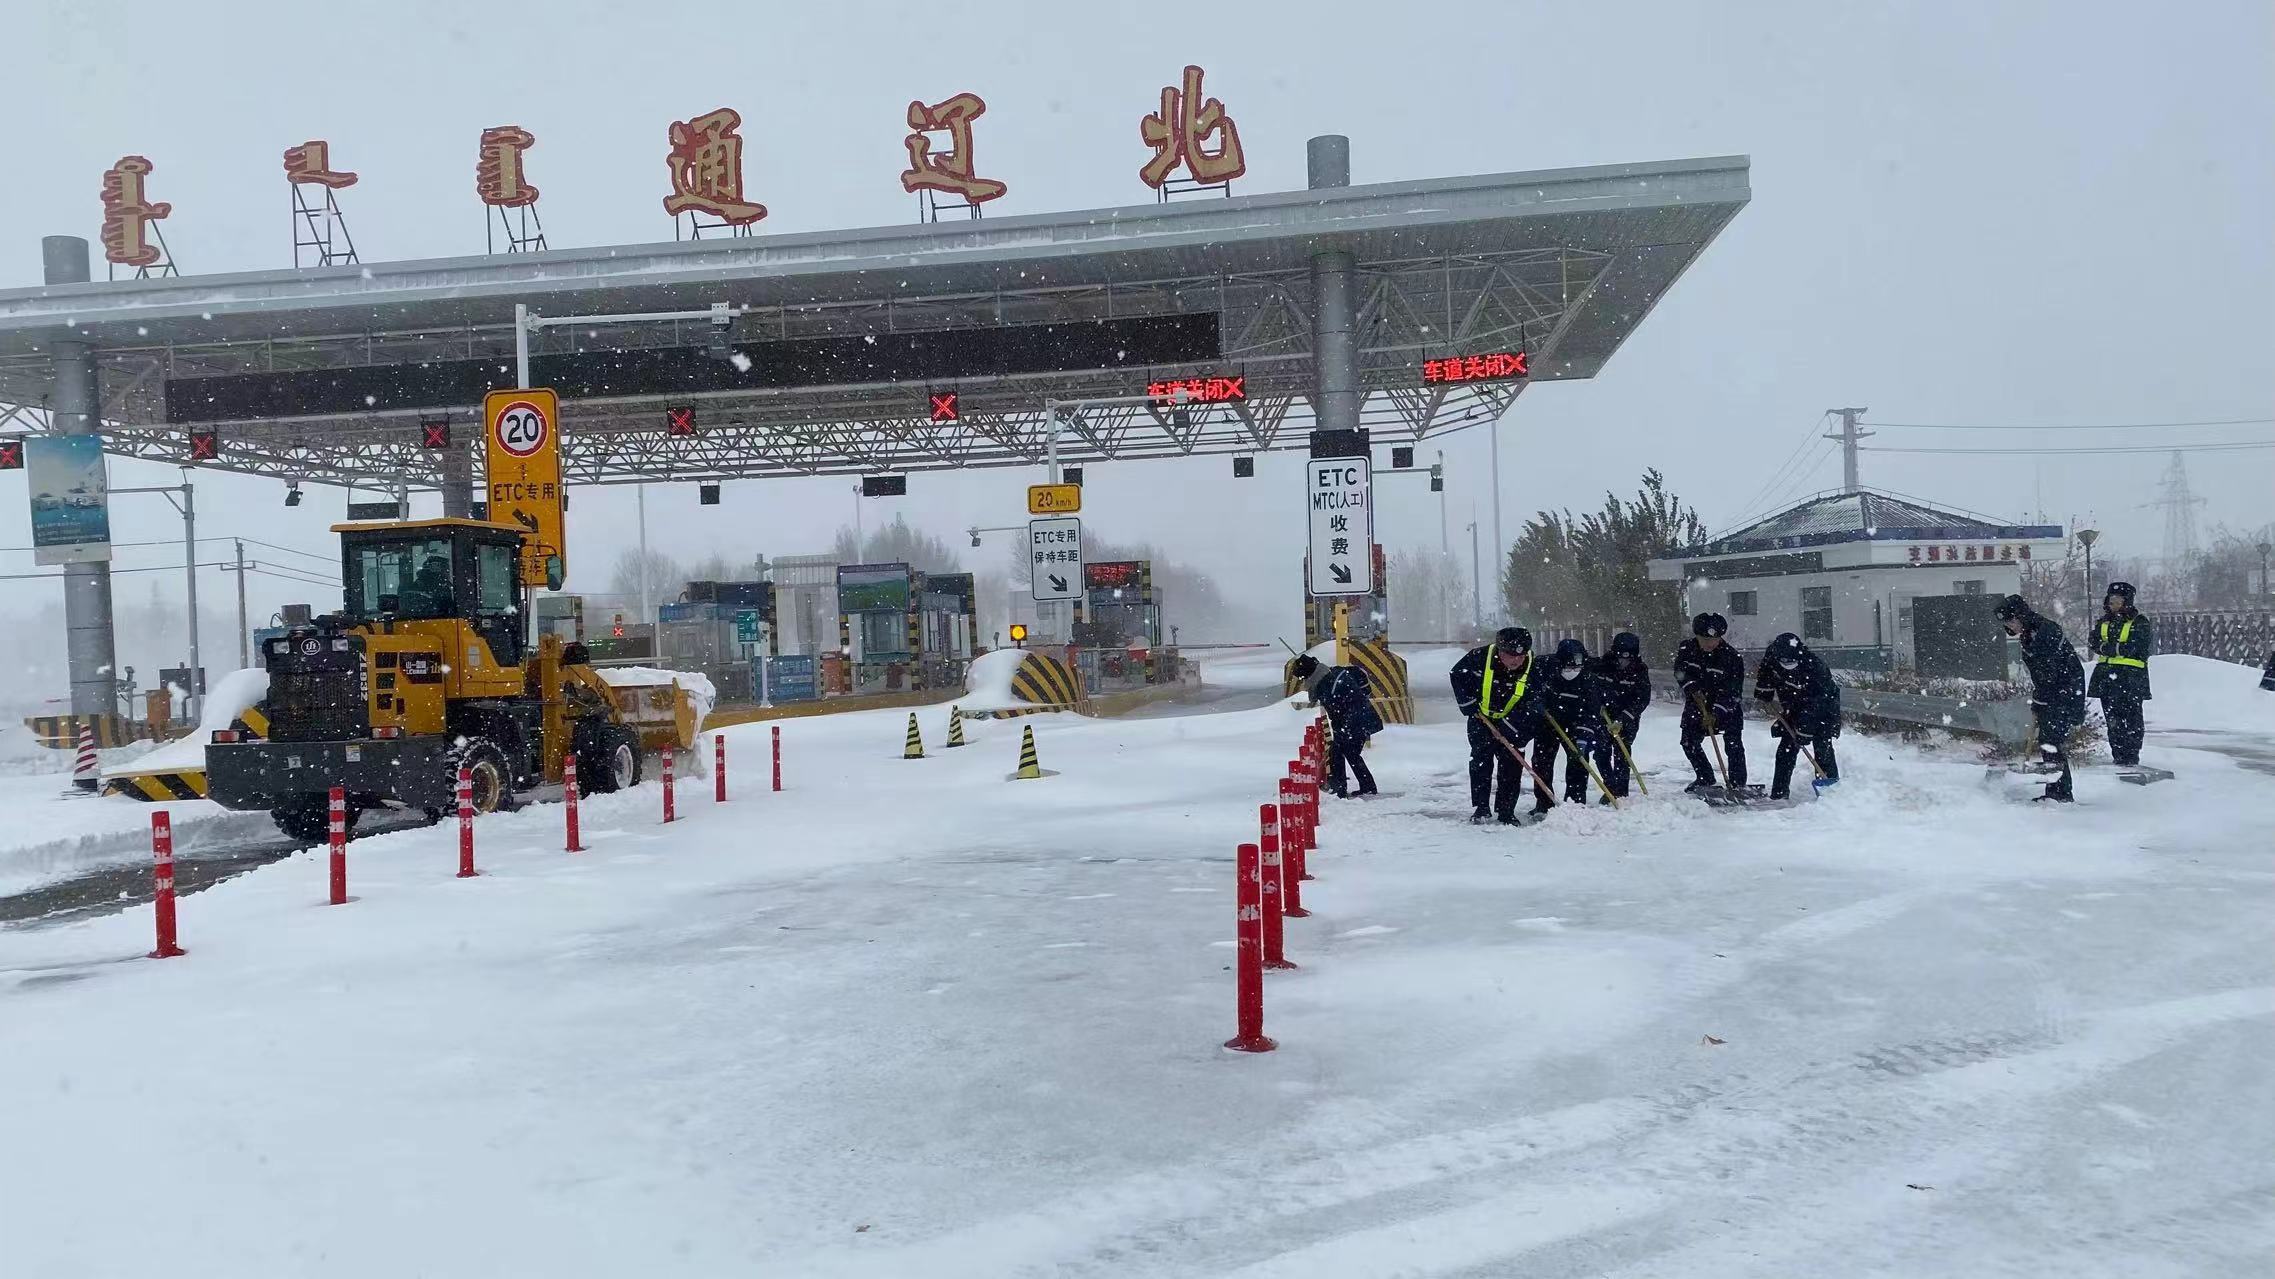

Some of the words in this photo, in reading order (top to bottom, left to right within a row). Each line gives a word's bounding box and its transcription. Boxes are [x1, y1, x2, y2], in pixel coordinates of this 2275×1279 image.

[663, 65, 1246, 225] 通辽北
[1424, 354, 1505, 381] 车道关闭
[506, 413, 539, 444] 20
[1319, 467, 1358, 487] ETC
[494, 482, 554, 501] ETC专用
[1037, 491, 1053, 508] 20
[1055, 498, 1072, 508] km/h
[1313, 491, 1364, 510] MTC(人工)
[1034, 529, 1077, 544] ETC专用
[1330, 515, 1349, 555] 收费
[1034, 549, 1079, 565] 保持车距
